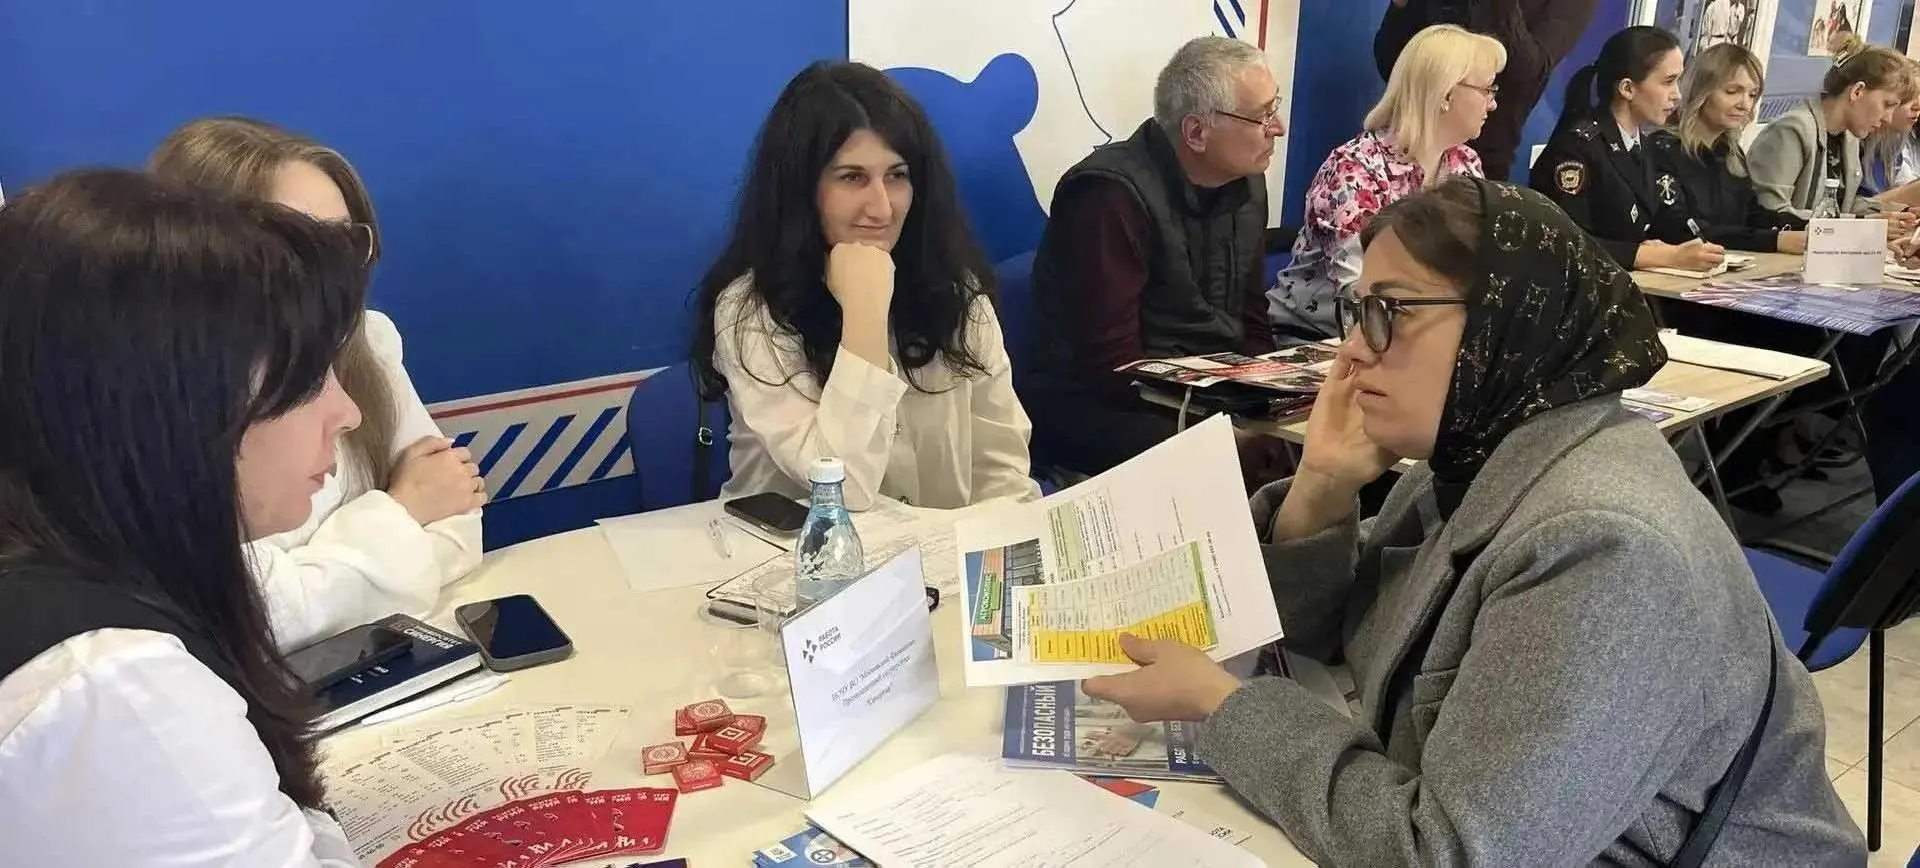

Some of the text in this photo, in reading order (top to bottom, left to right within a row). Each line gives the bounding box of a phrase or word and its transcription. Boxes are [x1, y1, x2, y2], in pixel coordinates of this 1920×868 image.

[818, 625, 839, 642] РАБОТА
[819, 632, 841, 652] РОССИИ
[1031, 683, 1057, 758] БЕЗОПАСНЫЙ
